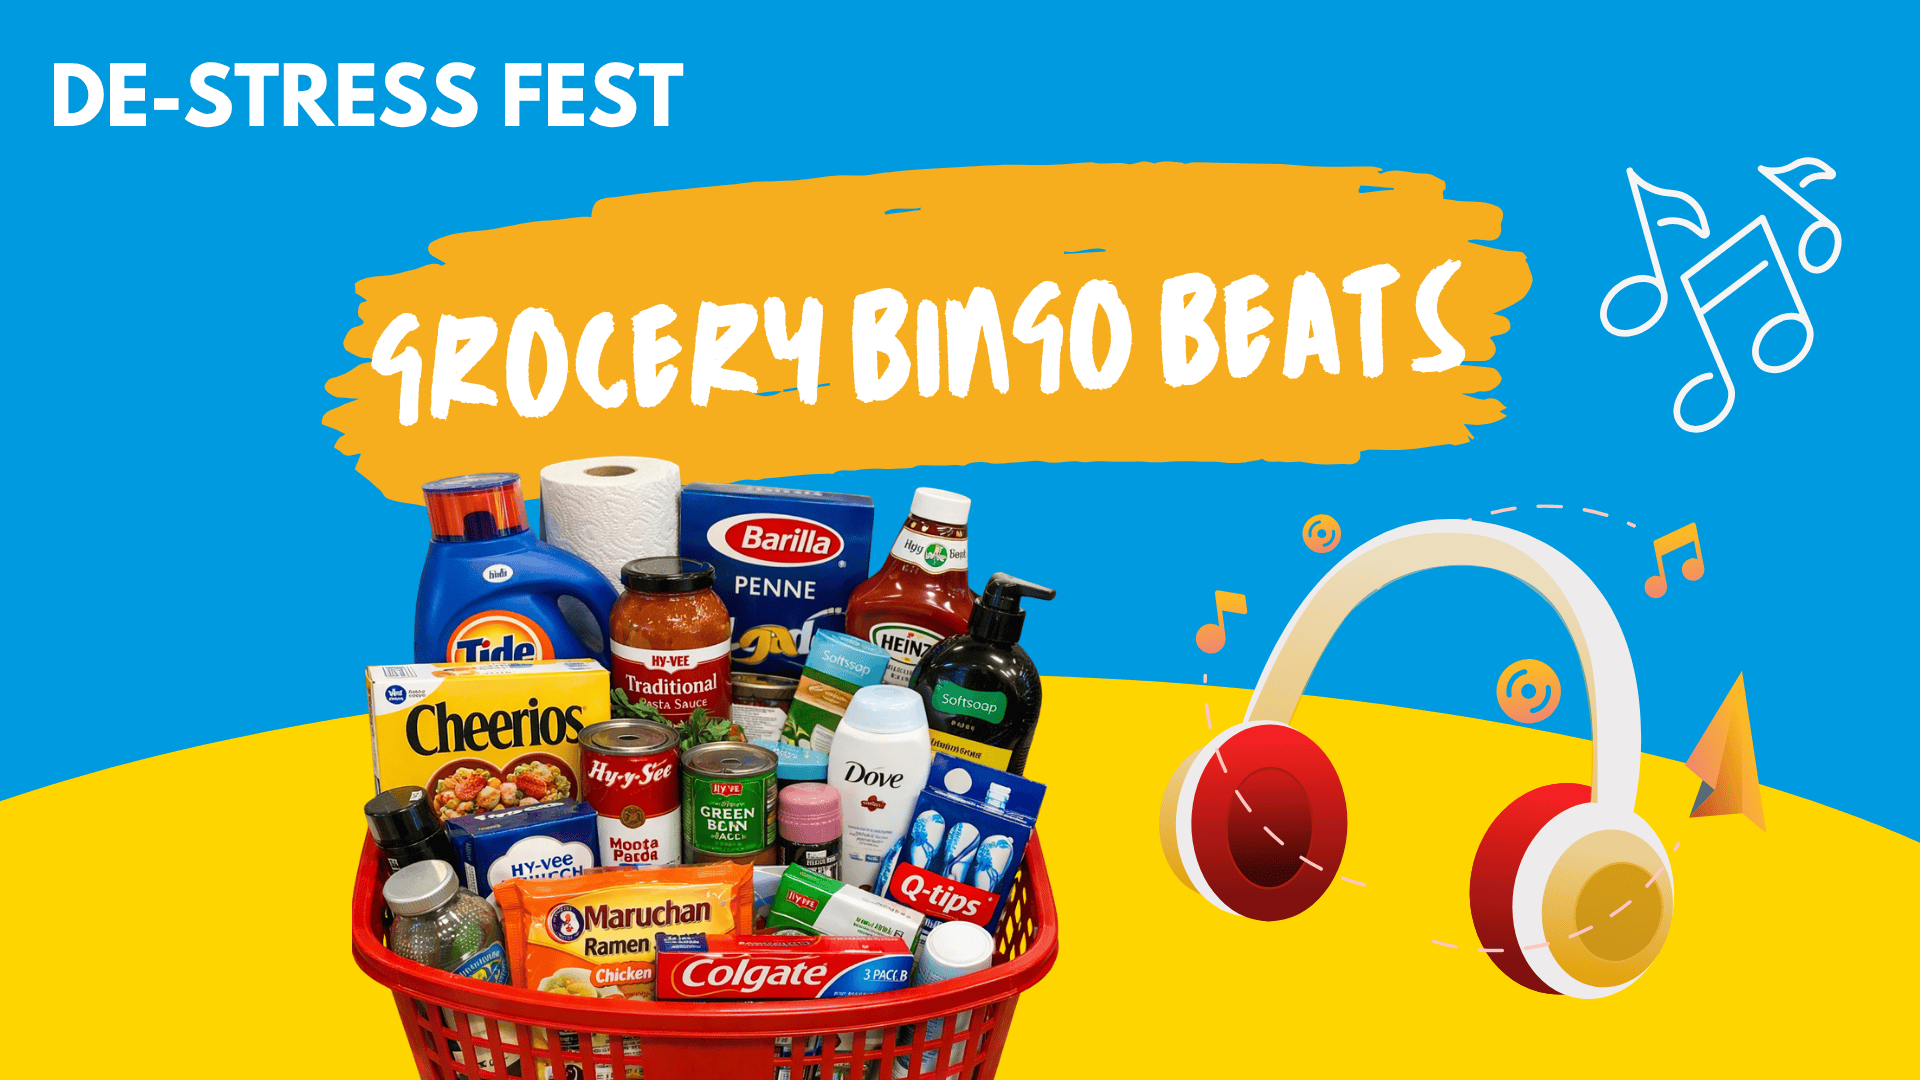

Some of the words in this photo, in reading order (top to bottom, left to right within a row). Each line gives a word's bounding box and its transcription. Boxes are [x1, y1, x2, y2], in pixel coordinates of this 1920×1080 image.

[54, 62, 478, 127] DE-STRESS
[505, 62, 683, 127] FEST
[371, 297, 823, 426] GROCERY
[852, 279, 1132, 403] BINGO
[1160, 259, 1465, 387] BEATS
[741, 525, 831, 555] Barilla
[735, 575, 816, 600] PENNE
[456, 634, 535, 663] Tide
[625, 672, 718, 695] Traditional
[942, 693, 998, 715] Softsoap
[406, 697, 584, 756] Cheerios
[844, 760, 904, 789] Dove
[700, 806, 755, 819] GREEN
[901, 874, 982, 916] Q-tips
[585, 900, 711, 931] Maruchan
[585, 938, 650, 956] Ramen
[595, 966, 652, 983] Chicken
[682, 959, 828, 992] Colgate
[863, 969, 871, 981] 3
